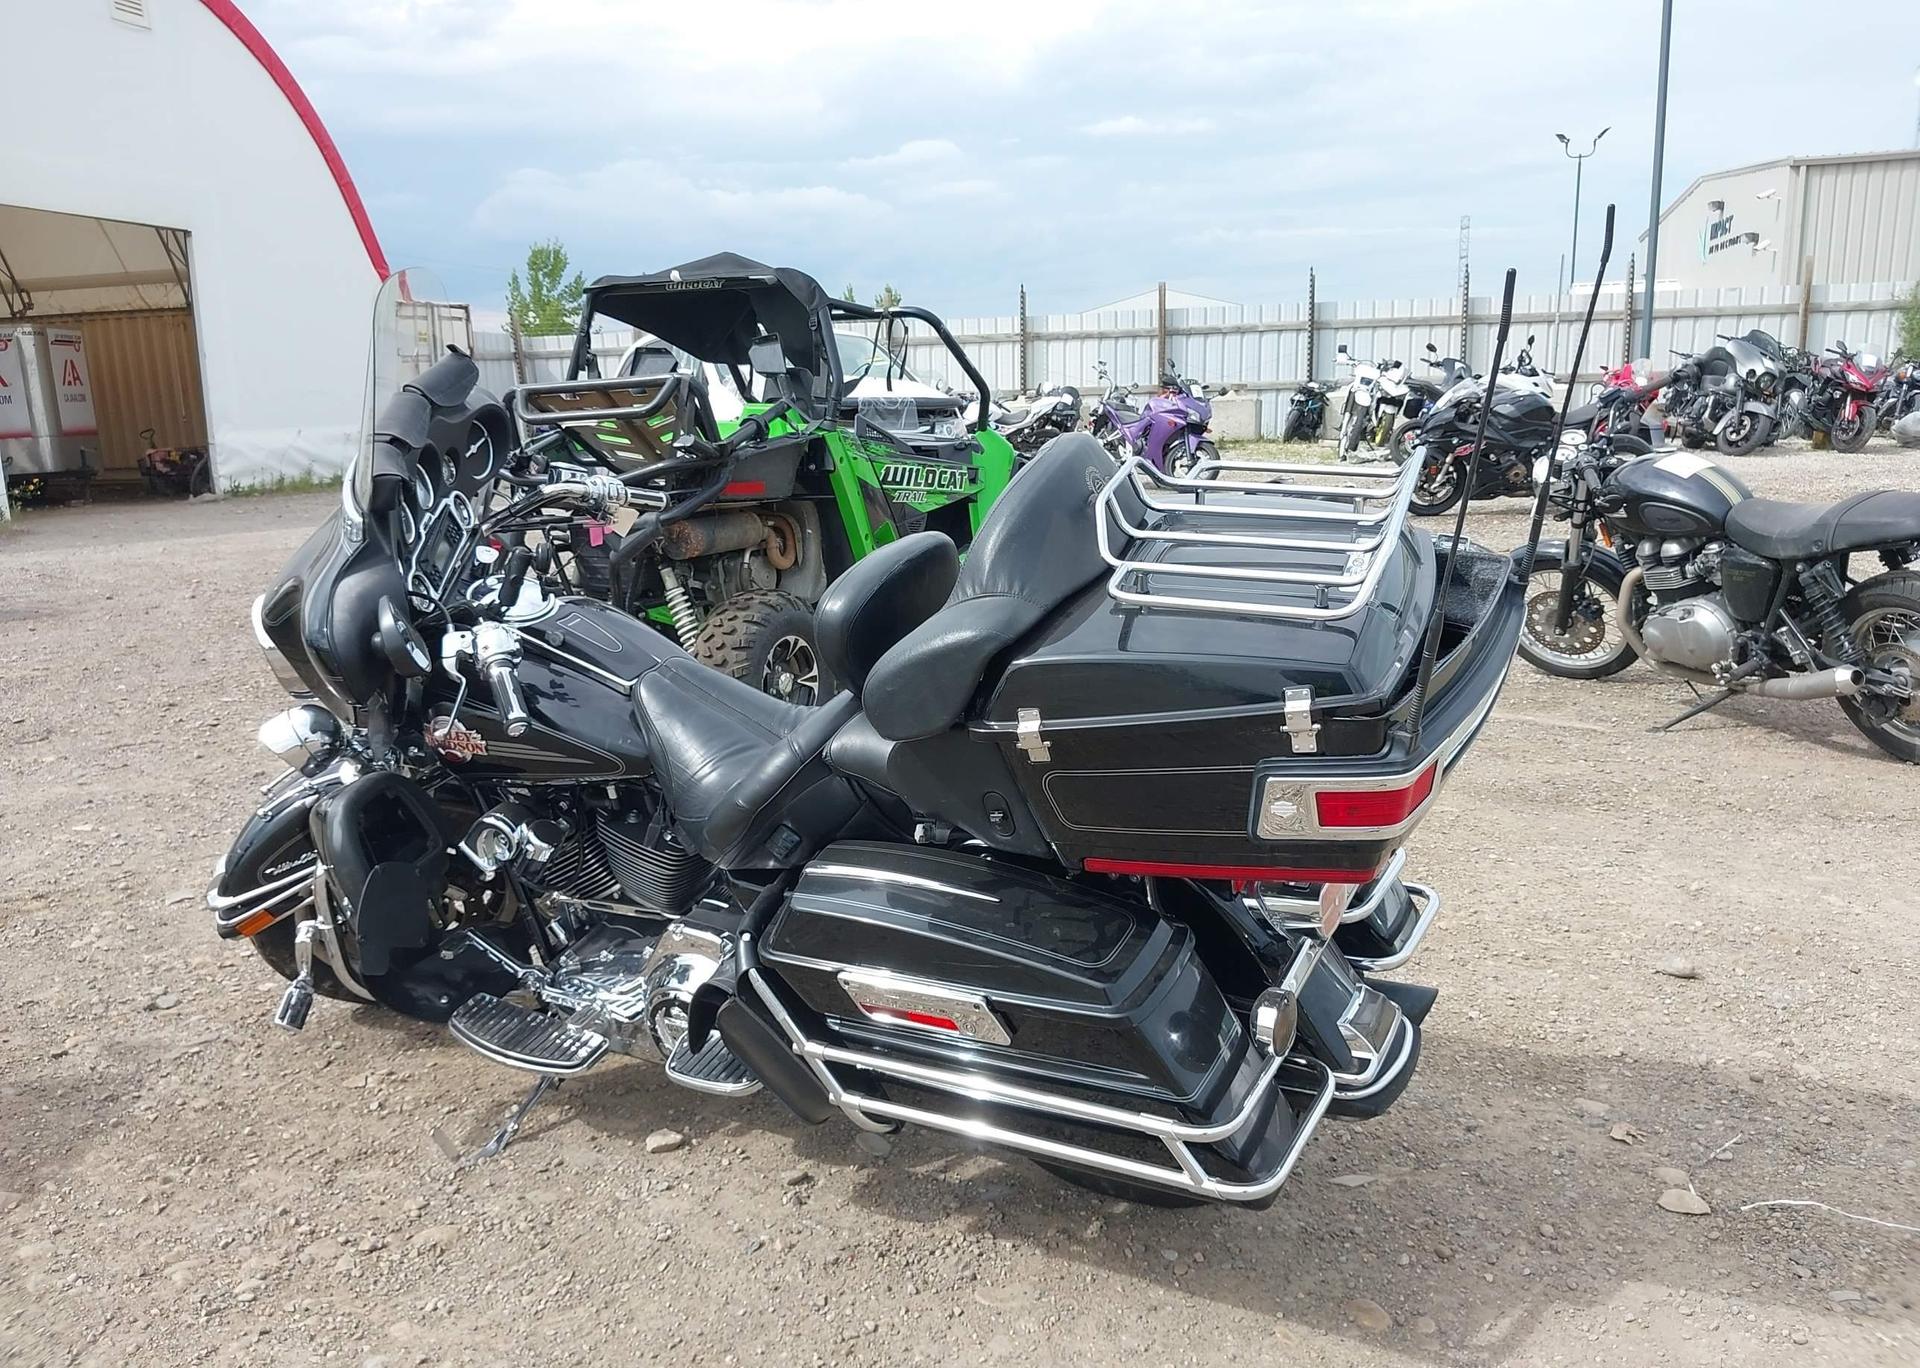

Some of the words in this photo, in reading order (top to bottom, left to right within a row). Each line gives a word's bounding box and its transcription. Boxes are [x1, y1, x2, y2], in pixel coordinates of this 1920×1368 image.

[666, 279, 725, 291] WILDCAT
[880, 465, 967, 491] WILDCAT
[893, 490, 927, 502] TRAIL
